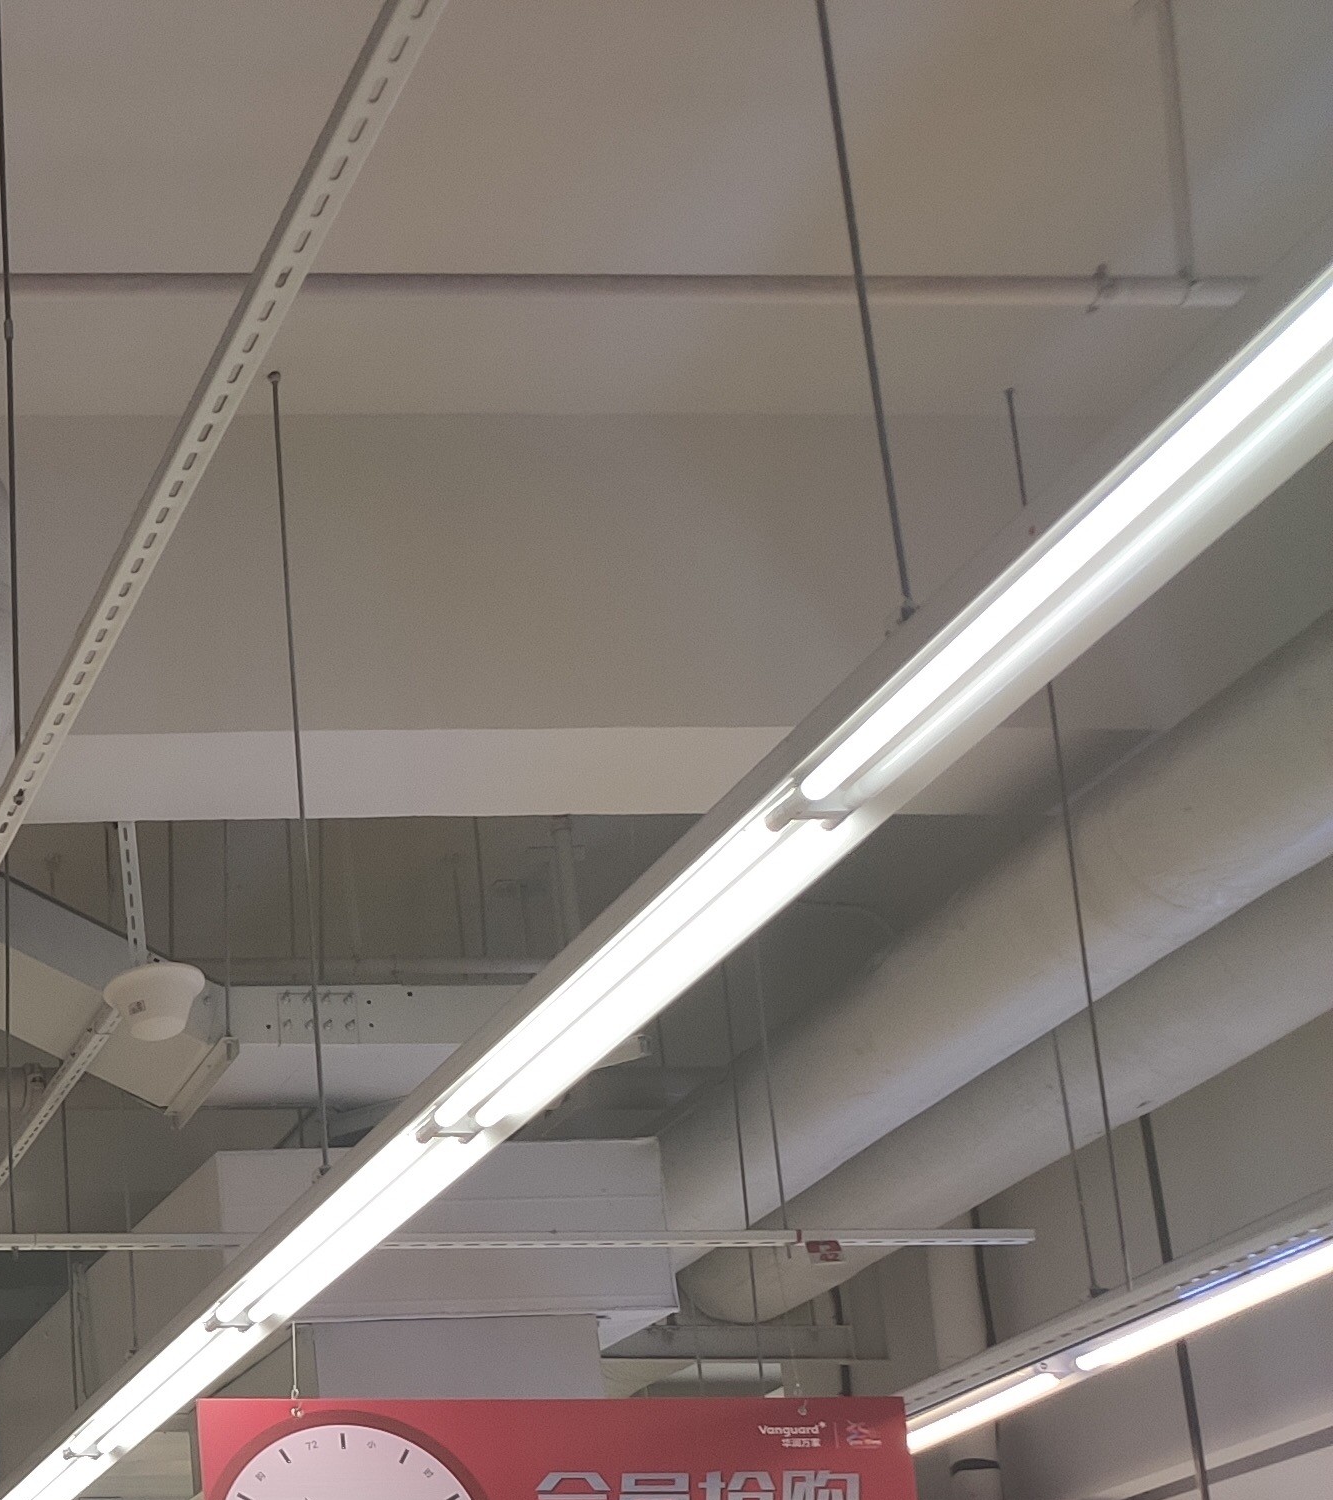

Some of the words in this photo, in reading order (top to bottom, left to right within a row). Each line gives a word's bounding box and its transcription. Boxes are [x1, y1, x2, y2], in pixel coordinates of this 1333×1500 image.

[758, 1424, 820, 1437] Vanguard
[782, 1438, 821, 1447] 华润万家
